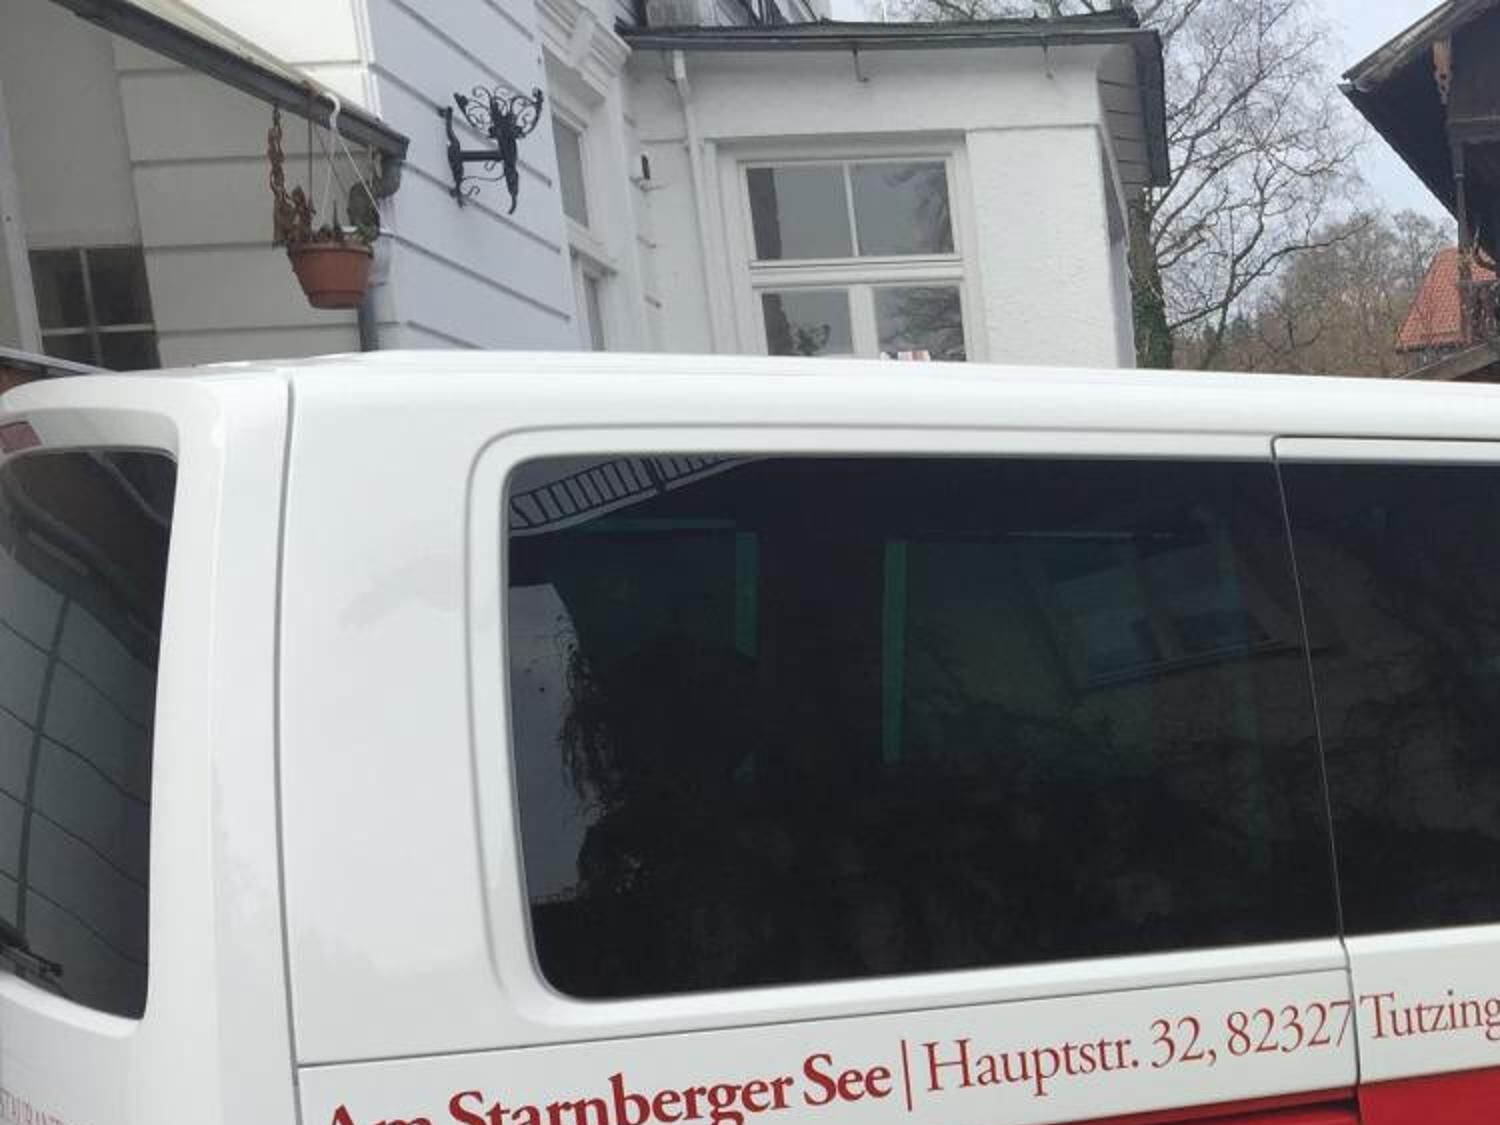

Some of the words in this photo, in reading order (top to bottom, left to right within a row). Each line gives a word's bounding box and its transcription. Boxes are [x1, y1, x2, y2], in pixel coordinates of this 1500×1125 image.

[802, 1053, 893, 1106] See
[922, 1036, 1140, 1097] Hauptstr.
[1149, 1015, 1218, 1068] 32,
[1226, 1000, 1355, 1057] 82327
